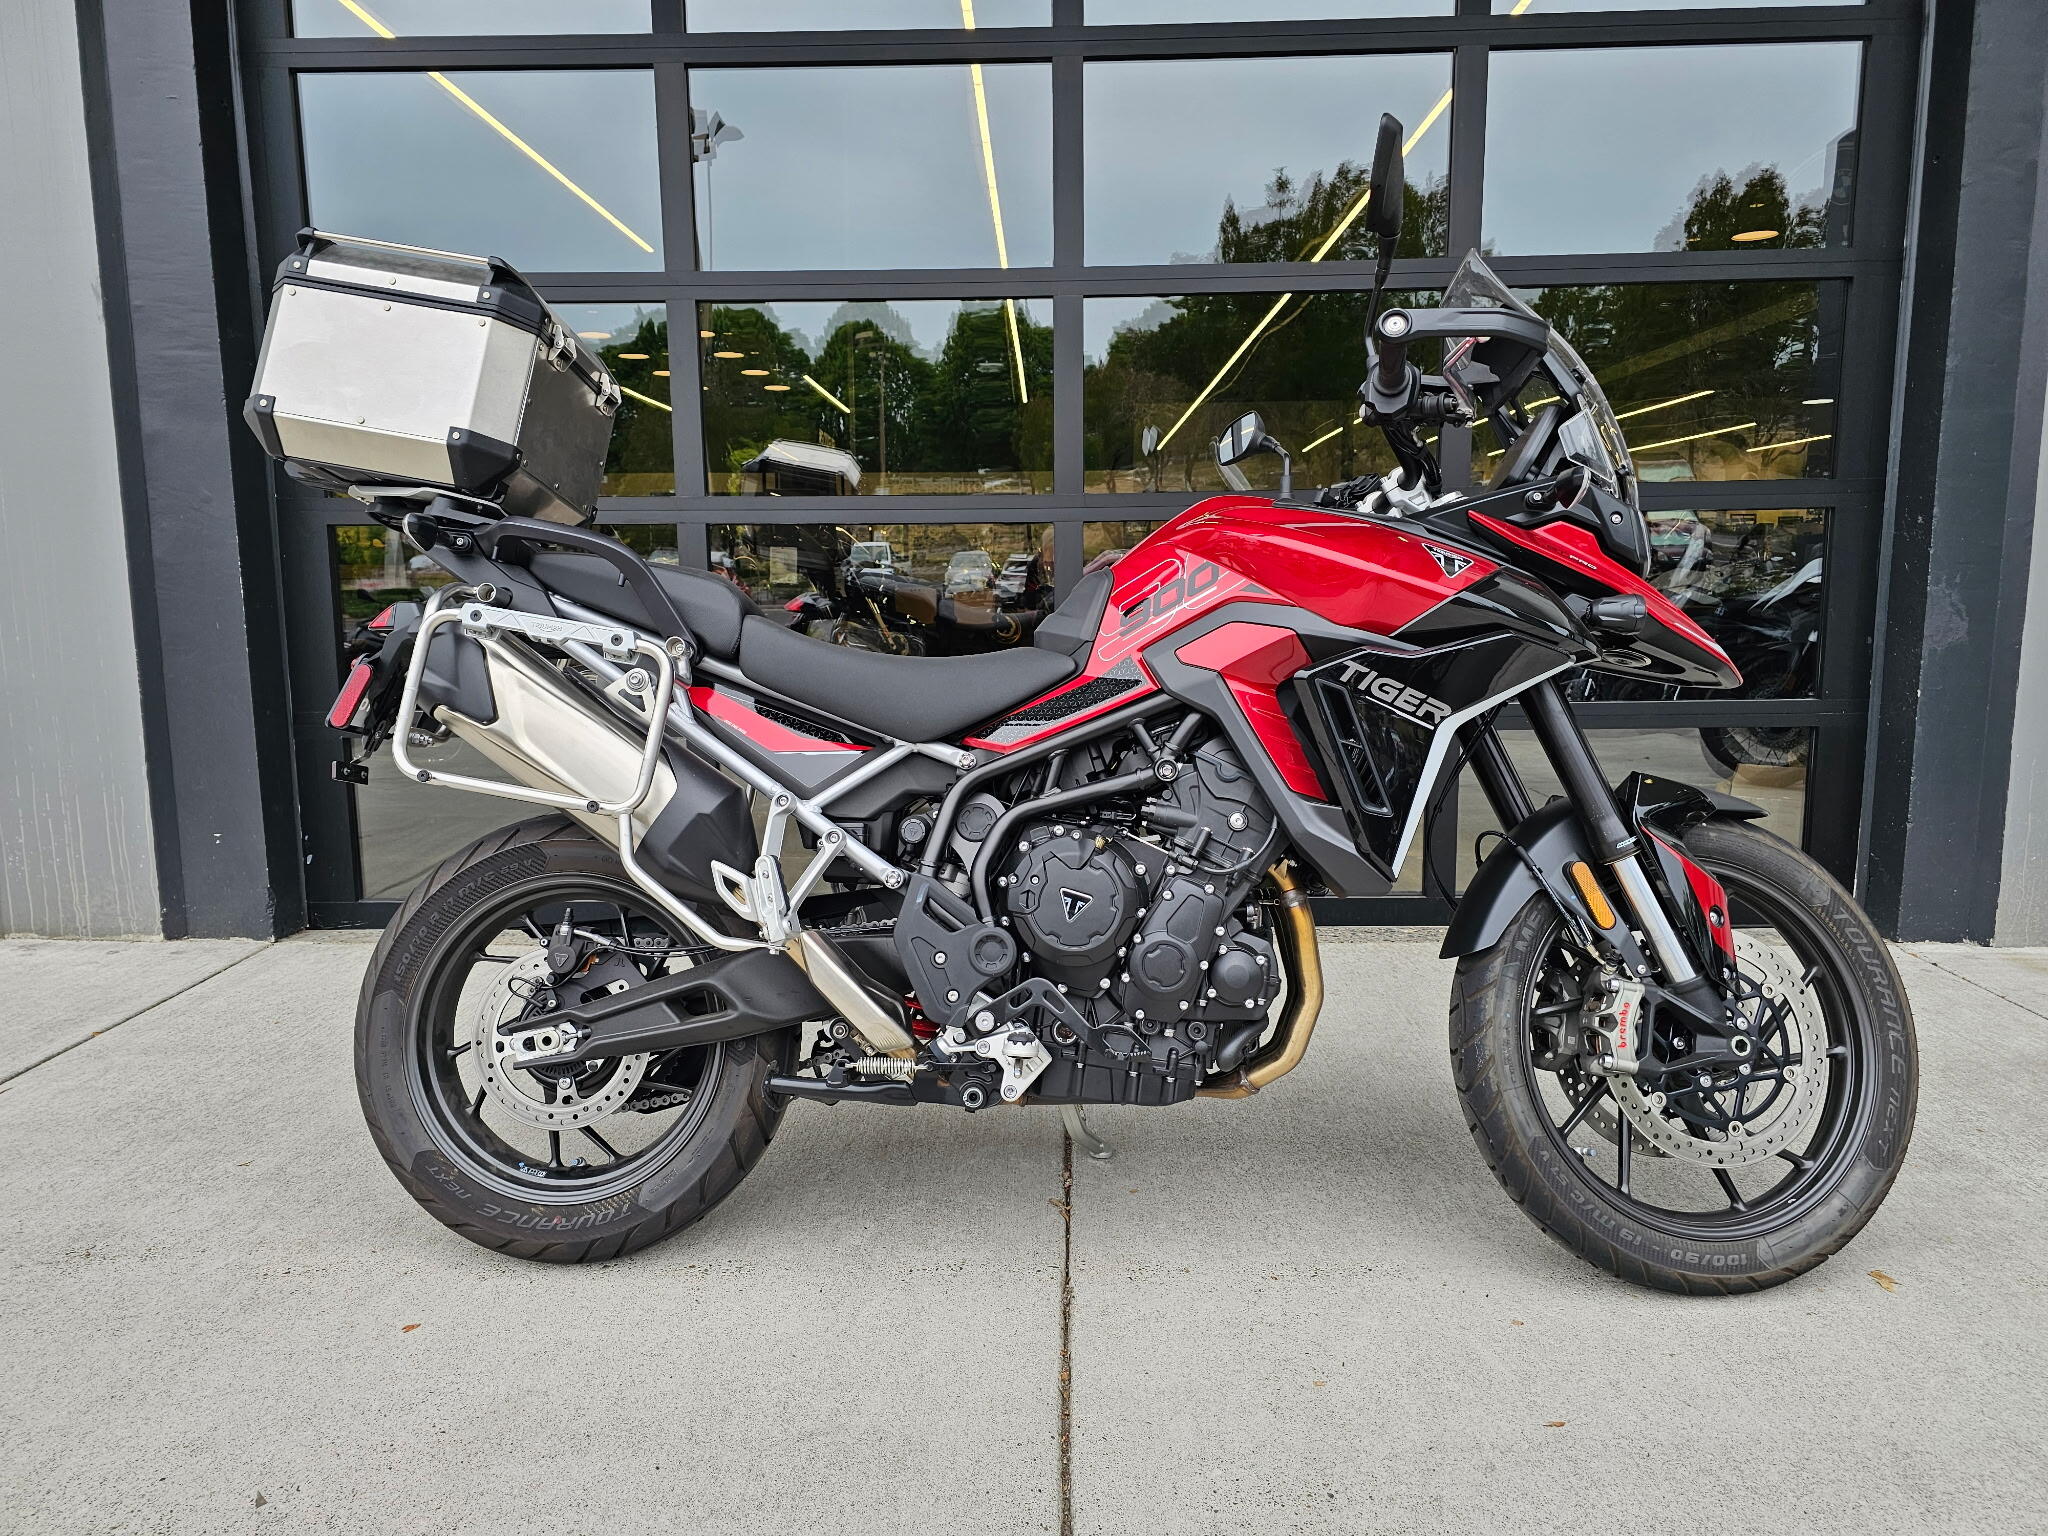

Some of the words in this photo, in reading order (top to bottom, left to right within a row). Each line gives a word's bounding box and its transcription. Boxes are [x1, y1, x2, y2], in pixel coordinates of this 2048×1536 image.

[1119, 560, 1219, 637] 900
[1340, 660, 1452, 724] TIGER
[1833, 907, 1907, 1075] TOURANCE
[1616, 1001, 1632, 1049] brembo
[476, 1200, 632, 1232] TOURANCE
[1618, 1228, 1643, 1246] 19
[1670, 1249, 1747, 1266] 100/90
